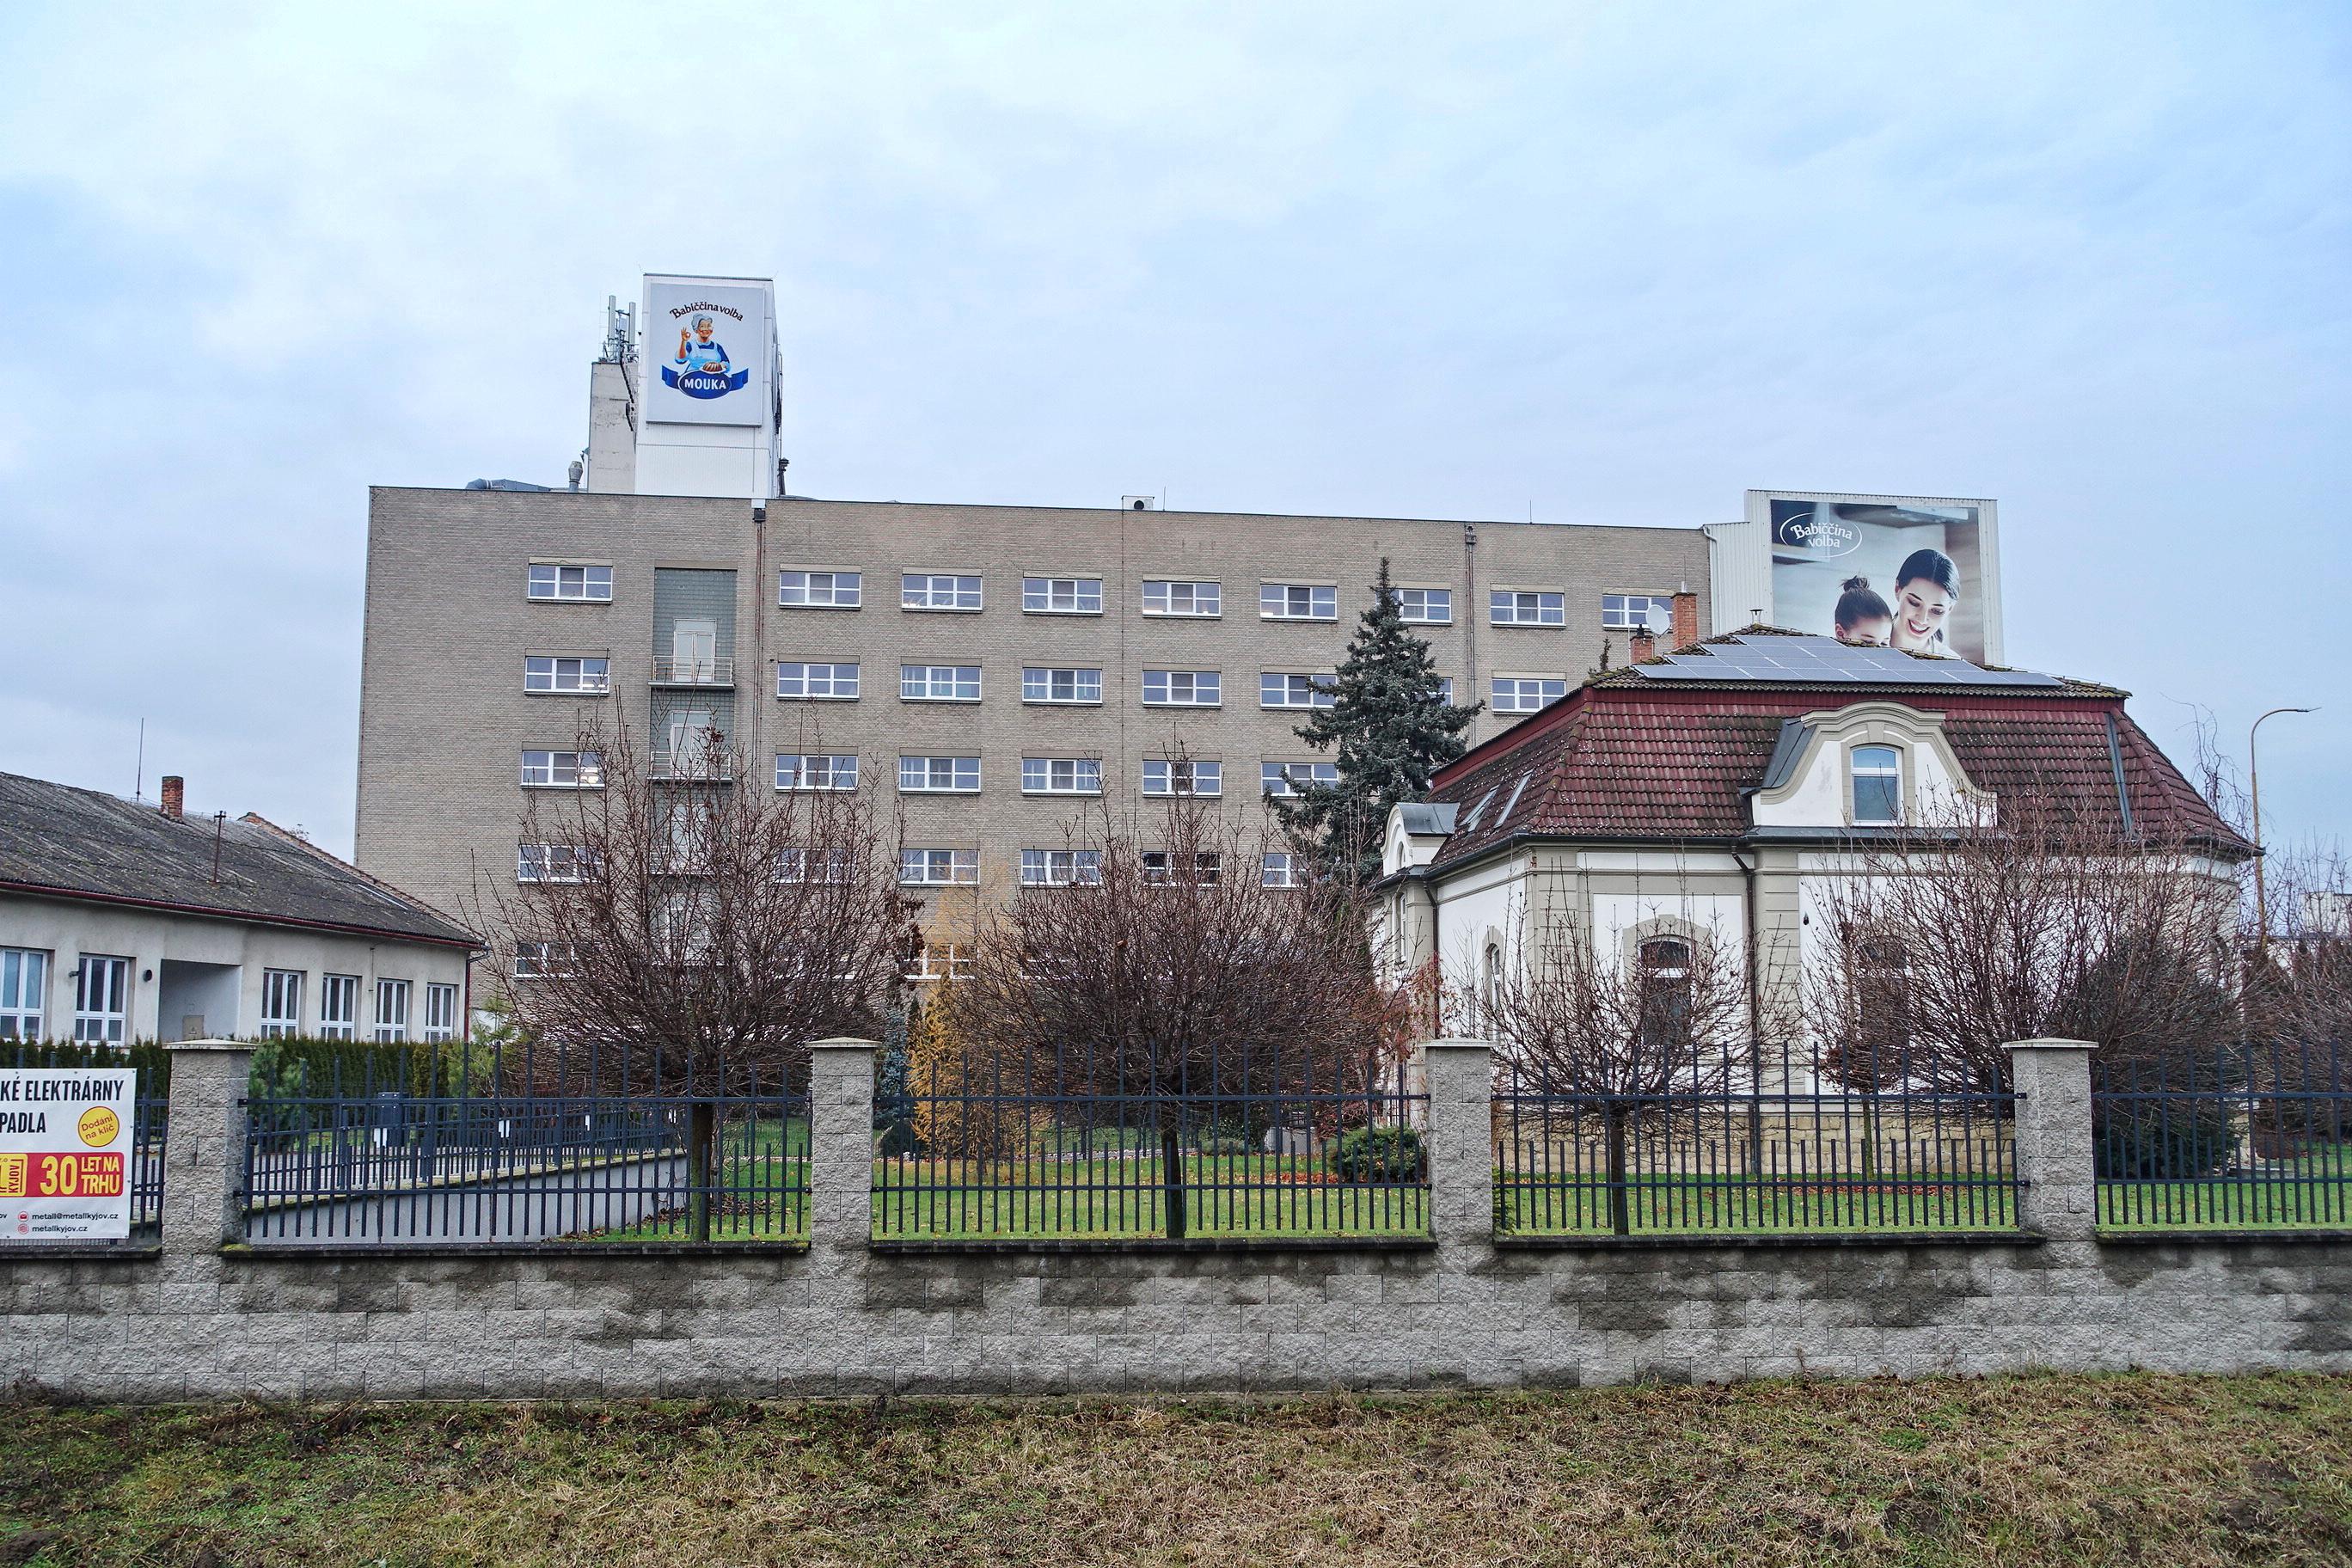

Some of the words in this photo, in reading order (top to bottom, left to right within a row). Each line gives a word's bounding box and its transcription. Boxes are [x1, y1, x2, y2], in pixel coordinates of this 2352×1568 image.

[670, 302, 719, 319] Babiččina
[720, 305, 744, 322] volba
[684, 378, 726, 389] MOUKA
[1790, 522, 1853, 540] Babiččina
[1808, 535, 1841, 548] volba
[0, 1075, 21, 1101] KÉ
[25, 1075, 125, 1101] ELEKTRÁRNY
[0, 1112, 46, 1133] PADLA
[81, 1113, 113, 1132] Dodání
[85, 1131, 97, 1140] na
[81, 1156, 102, 1173] LET
[102, 1156, 120, 1172] NA
[8, 1165, 21, 1193] KYJOV
[40, 1155, 77, 1195] 30
[81, 1173, 120, 1195] TRHU
